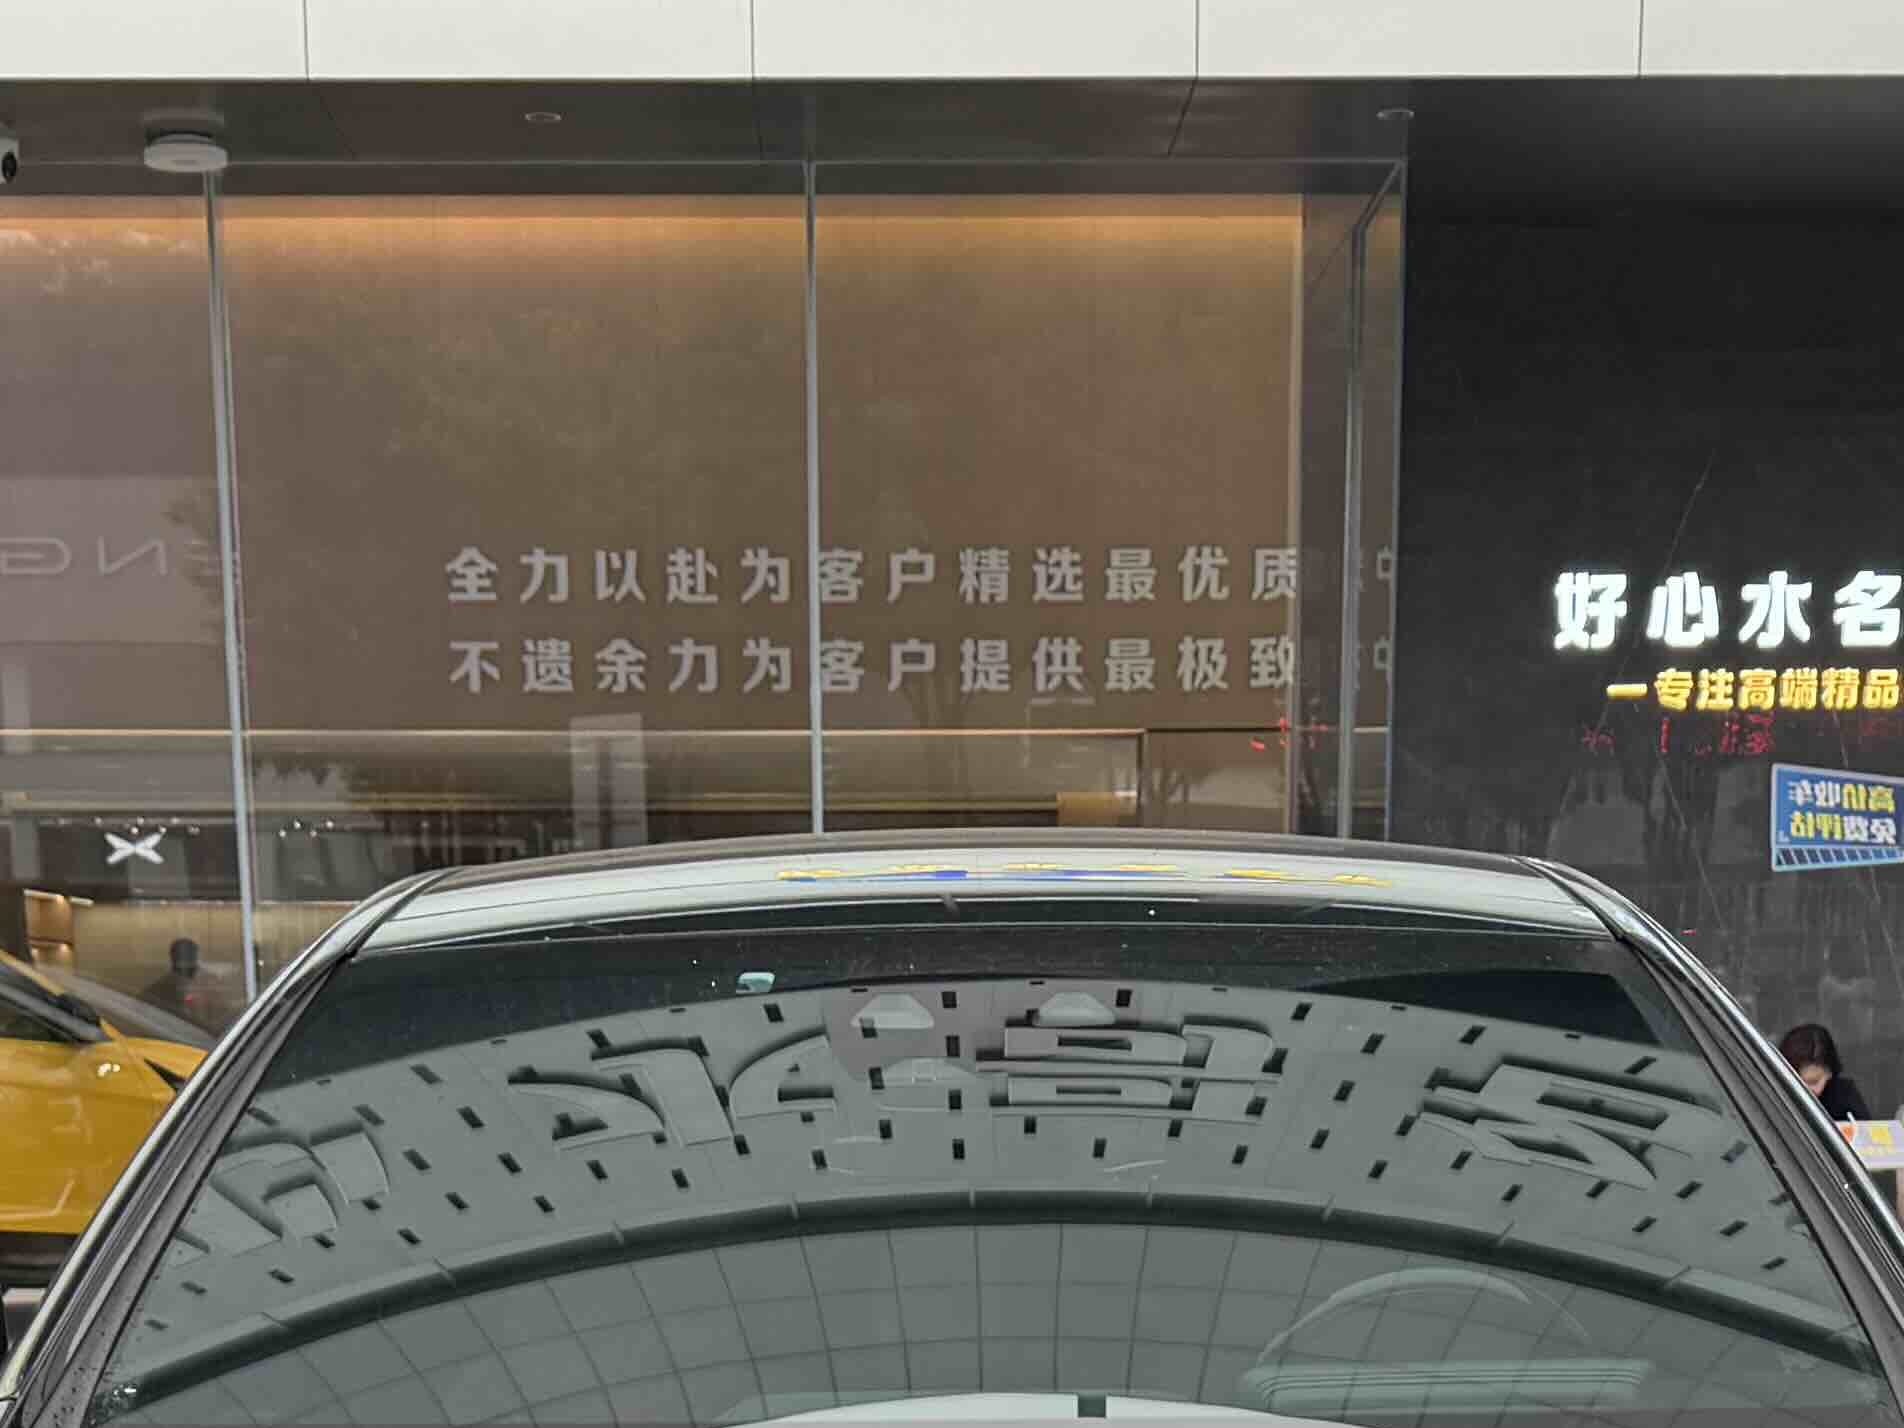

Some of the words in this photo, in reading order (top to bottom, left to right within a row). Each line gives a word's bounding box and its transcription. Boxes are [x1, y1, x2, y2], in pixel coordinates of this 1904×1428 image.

[448, 636, 1295, 691] 不遗余力为客户提供最极致
